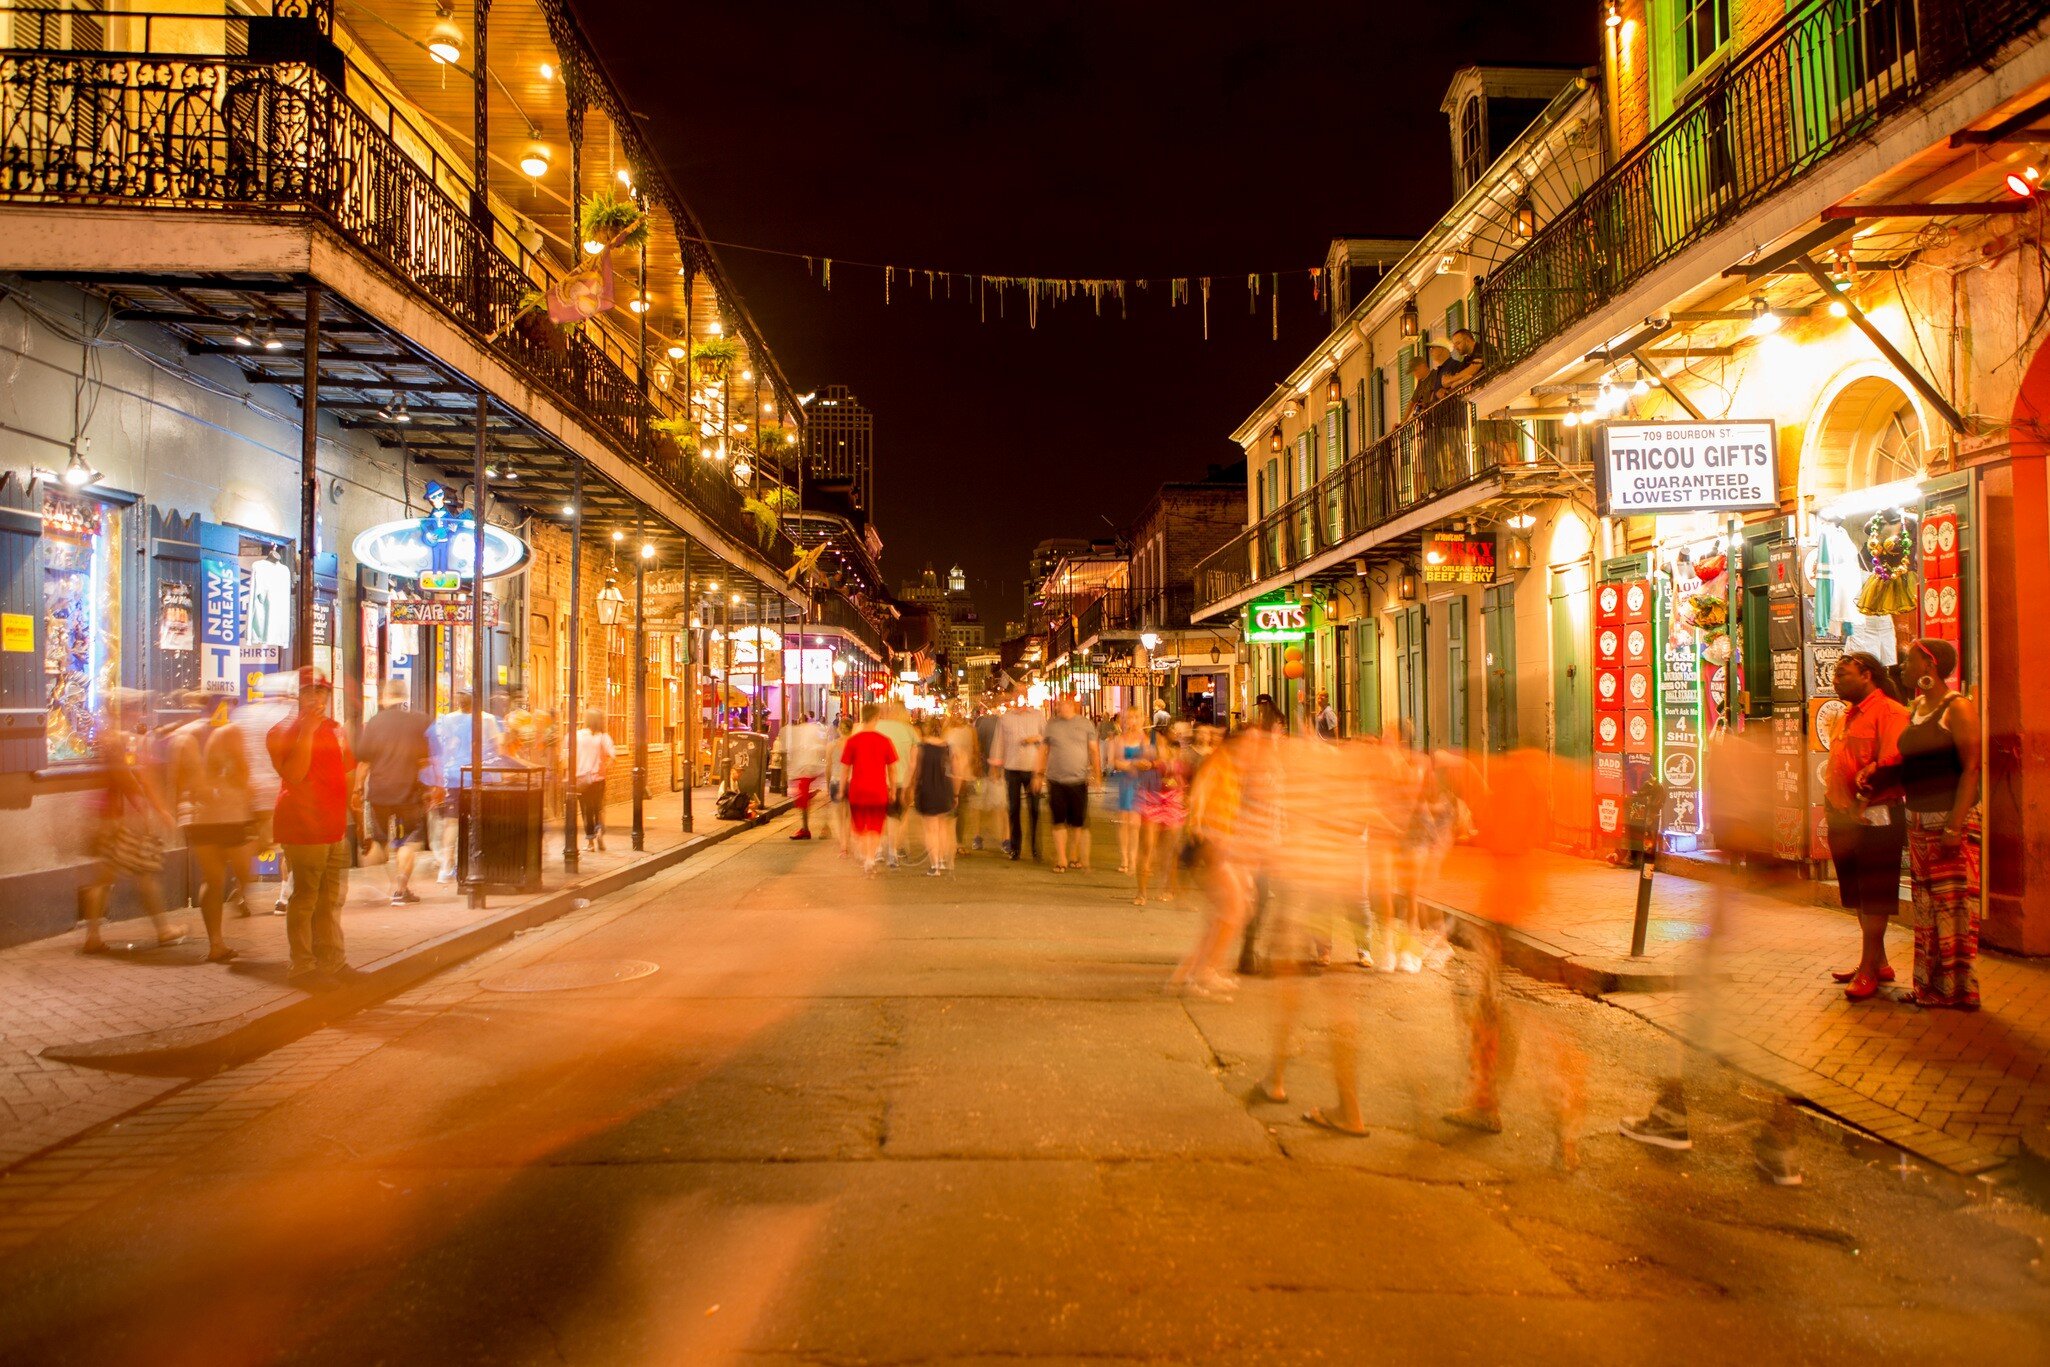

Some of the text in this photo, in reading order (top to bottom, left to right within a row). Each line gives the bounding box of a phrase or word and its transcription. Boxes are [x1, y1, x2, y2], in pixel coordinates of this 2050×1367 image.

[1643, 429, 1734, 441] 709 BOURBON ST.
[1612, 444, 1768, 471] TRICOU GIFTS
[1634, 473, 1749, 490] GUARANTEED
[1622, 487, 1761, 504] LOWEST PRICES
[1442, 565, 1474, 573] ORLEANS
[1426, 572, 1493, 582] BEEF JERKY
[657, 578, 697, 595] Embes
[1677, 582, 1699, 593] LOV
[208, 571, 222, 636] NEW
[222, 569, 234, 642] ORLEANS
[624, 597, 655, 607] STAK
[413, 602, 444, 620] VAPE
[1256, 609, 1306, 630] CATS
[211, 648, 231, 678] T
[1673, 662, 1693, 672] GOT
[206, 681, 235, 693] SHIRTS
[1674, 681, 1688, 690] ON
[210, 700, 230, 727] 4
[1665, 707, 1679, 716] Don't
[1680, 708, 1690, 716] Ask
[1676, 716, 1686, 731] 4
[1667, 732, 1696, 742] SHIT
[1669, 791, 1698, 799] SUPPORT
